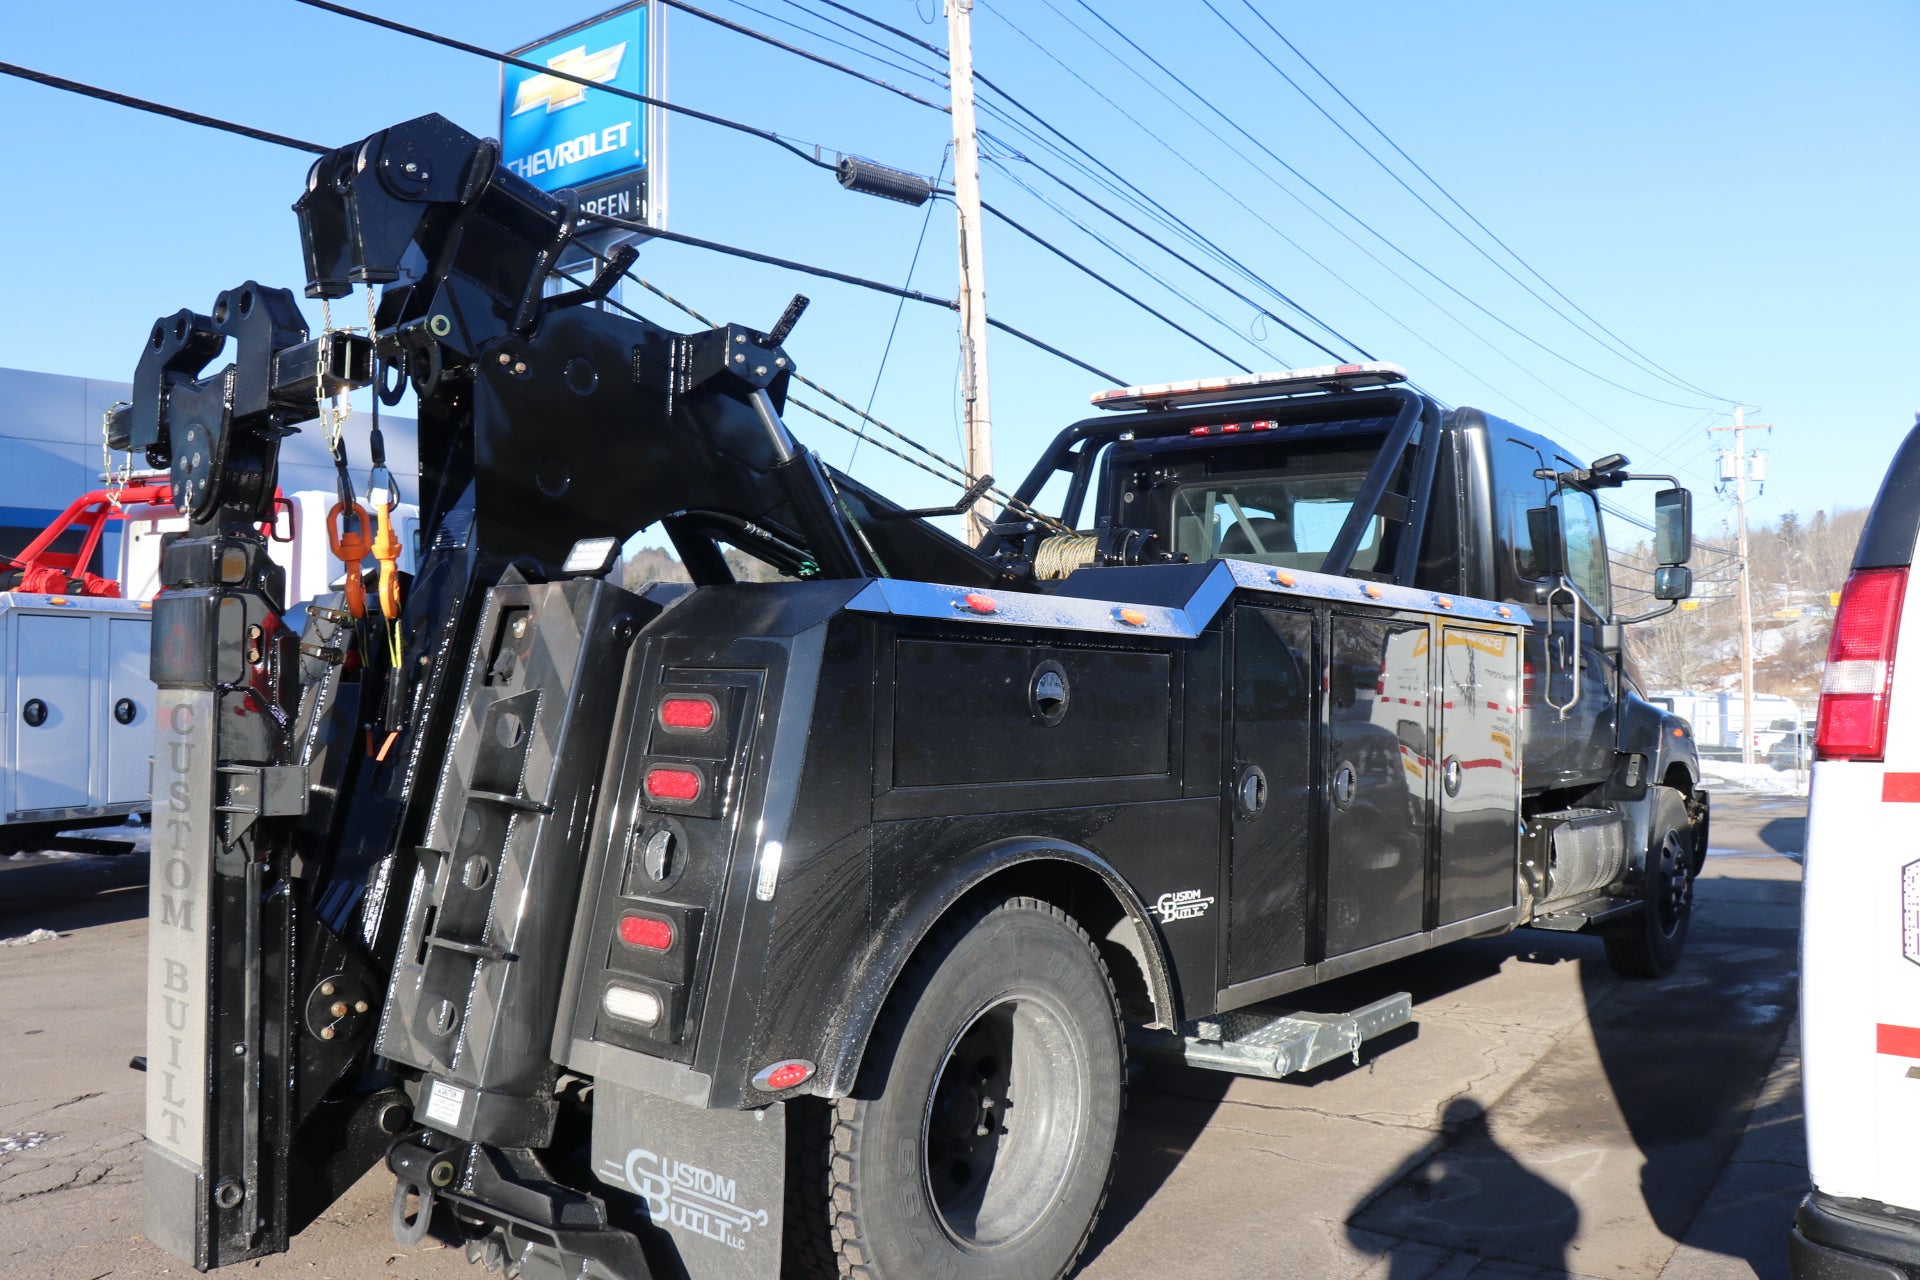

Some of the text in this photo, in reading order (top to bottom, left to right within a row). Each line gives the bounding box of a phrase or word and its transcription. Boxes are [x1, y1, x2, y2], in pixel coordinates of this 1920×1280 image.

[161, 703, 195, 1145] CUSTOM BUILT
[727, 1235, 746, 1251] LLC
